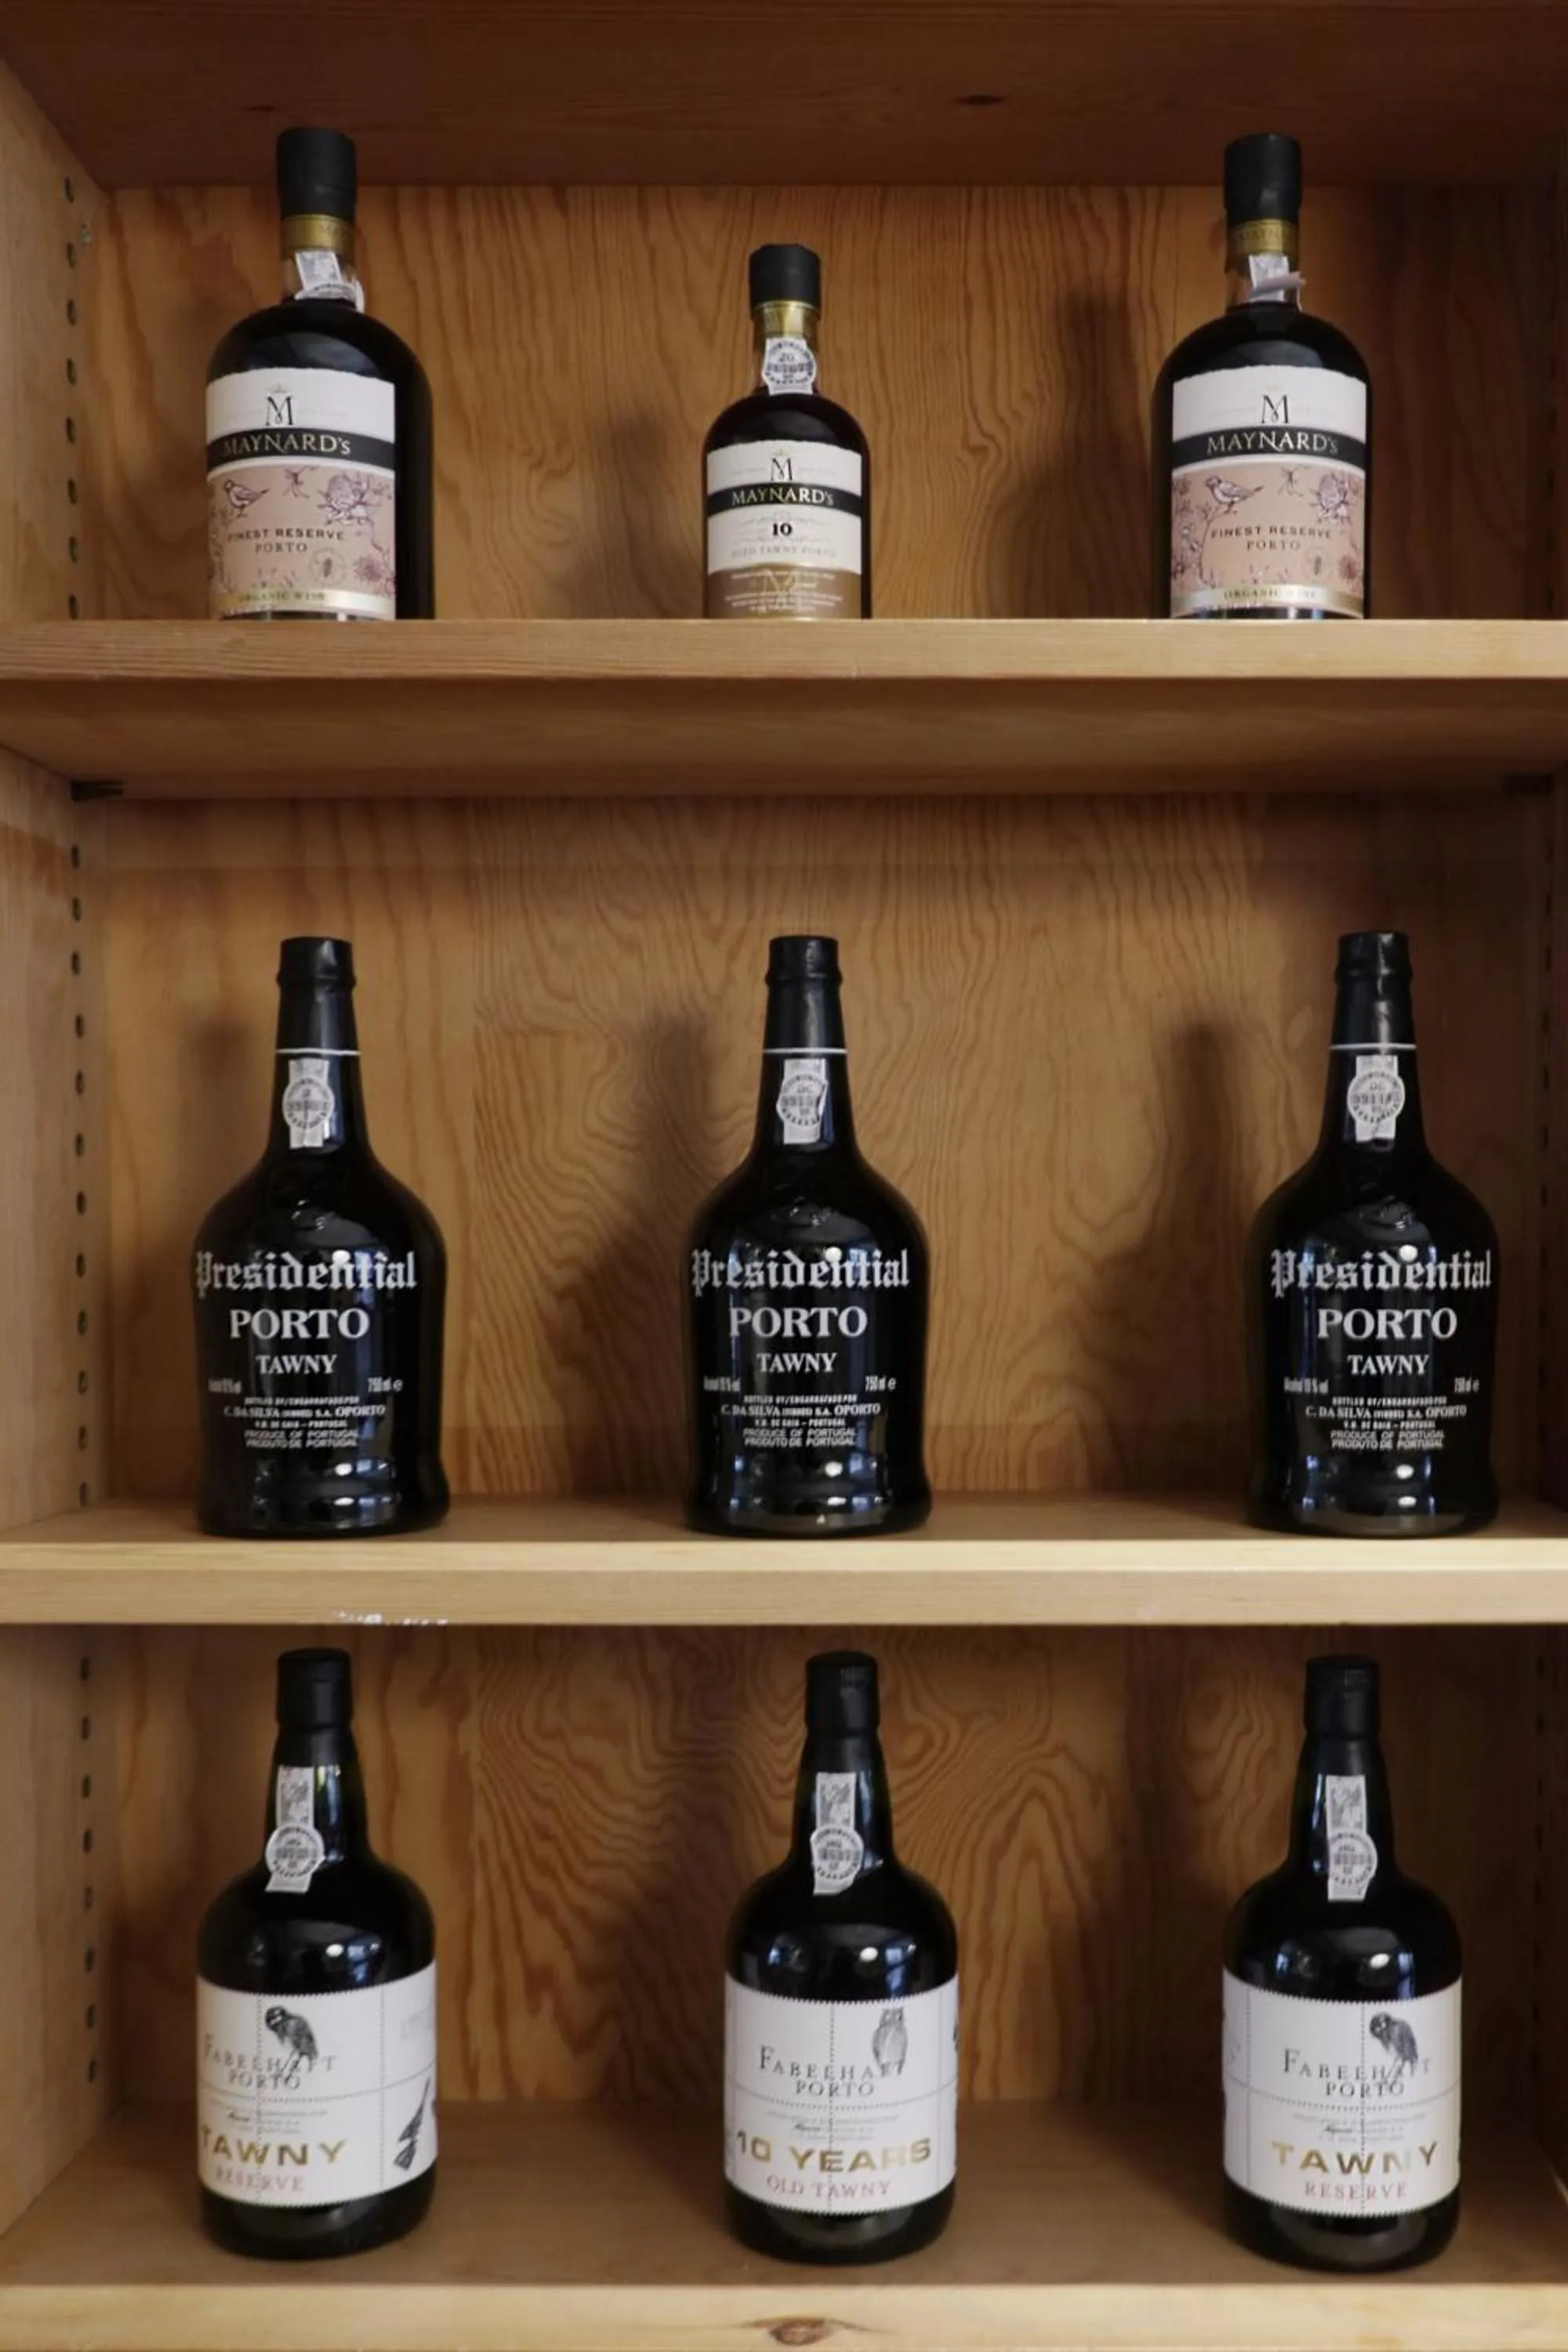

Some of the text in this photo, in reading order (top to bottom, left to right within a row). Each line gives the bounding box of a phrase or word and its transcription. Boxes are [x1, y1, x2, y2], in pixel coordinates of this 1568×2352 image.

[267, 396, 293, 426] M
[1261, 394, 1289, 424] M
[771, 457, 793, 481] M
[275, 528, 346, 540] RESERVE
[772, 523, 793, 536] 10
[1211, 526, 1332, 539] FINEST RESERVE
[256, 542, 307, 553] PORTO
[1247, 540, 1301, 551] PORTO
[196, 1250, 417, 1299] Presidential
[692, 1248, 909, 1297] Presidential
[1270, 1248, 1491, 1298] Presidential
[230, 1308, 370, 1339] PORTO
[730, 1306, 868, 1338] PORTO
[1317, 1308, 1457, 1339] PORTO
[256, 1354, 337, 1374] TAWNY
[757, 1352, 837, 1372] TAWNY
[1347, 1354, 1429, 1374] TAWNY
[335, 1404, 385, 1417] OPORTO
[834, 1403, 880, 1415] OPORTO
[1426, 1404, 1467, 1417] OPORTO
[230, 2069, 300, 2090] PORTO
[796, 2080, 874, 2098] PORTO
[1326, 2082, 1404, 2098] PORTO
[201, 2124, 346, 2166] TAWNY
[737, 2129, 931, 2172] 10 YEARS
[1272, 2141, 1438, 2175] TAWNY
[766, 2175, 891, 2198] OLD TAWNY
[1305, 2181, 1407, 2200] RESERVE
